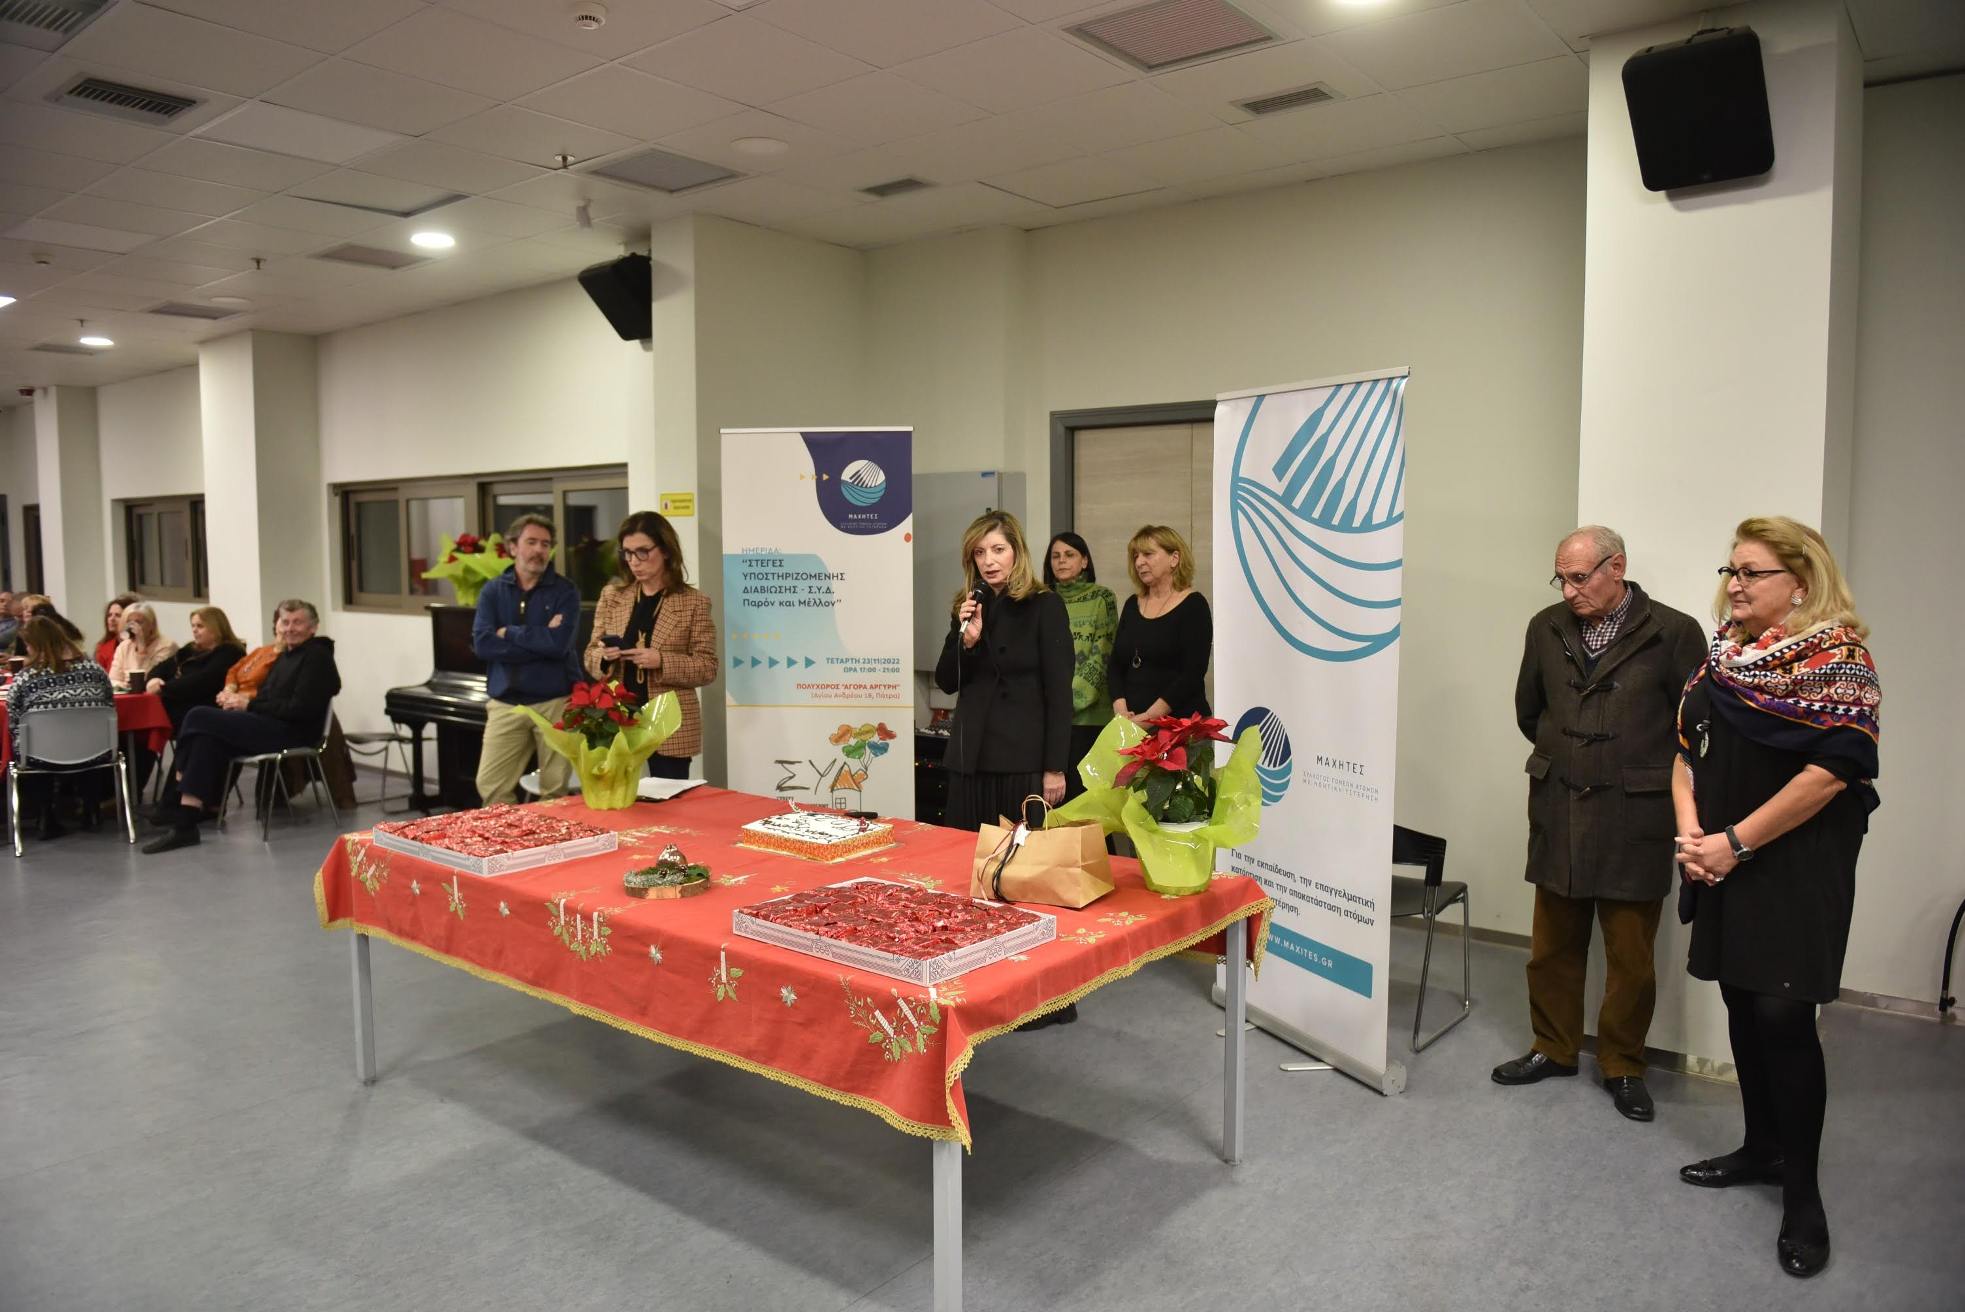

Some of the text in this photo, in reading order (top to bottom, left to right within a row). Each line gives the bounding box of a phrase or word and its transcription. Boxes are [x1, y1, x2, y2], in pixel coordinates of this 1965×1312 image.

[742, 572, 846, 581] ΥΠΟΣΤΗΡΙΖΟΜΕΝΗΣ
[742, 585, 798, 594] ΔΙΑΒΙΩΣΗΣ
[808, 585, 835, 594] Σ.Υ.Δ.
[743, 598, 776, 609] Παρόν
[779, 600, 795, 608] και
[826, 657, 860, 665] ΤΕΤΑΡΤΗ
[1316, 755, 1365, 776] ΜΑΧΗΤΕΣ
[1231, 848, 1376, 911] Για την εκπαίδευση, την επαγγελματική
[1263, 878, 1275, 888] και
[1276, 883, 1288, 895] την
[1288, 888, 1342, 917] αποκατάσταση
[1343, 909, 1375, 927] ατόμων
[1267, 933, 1334, 969] WW.MAXITES.GR
